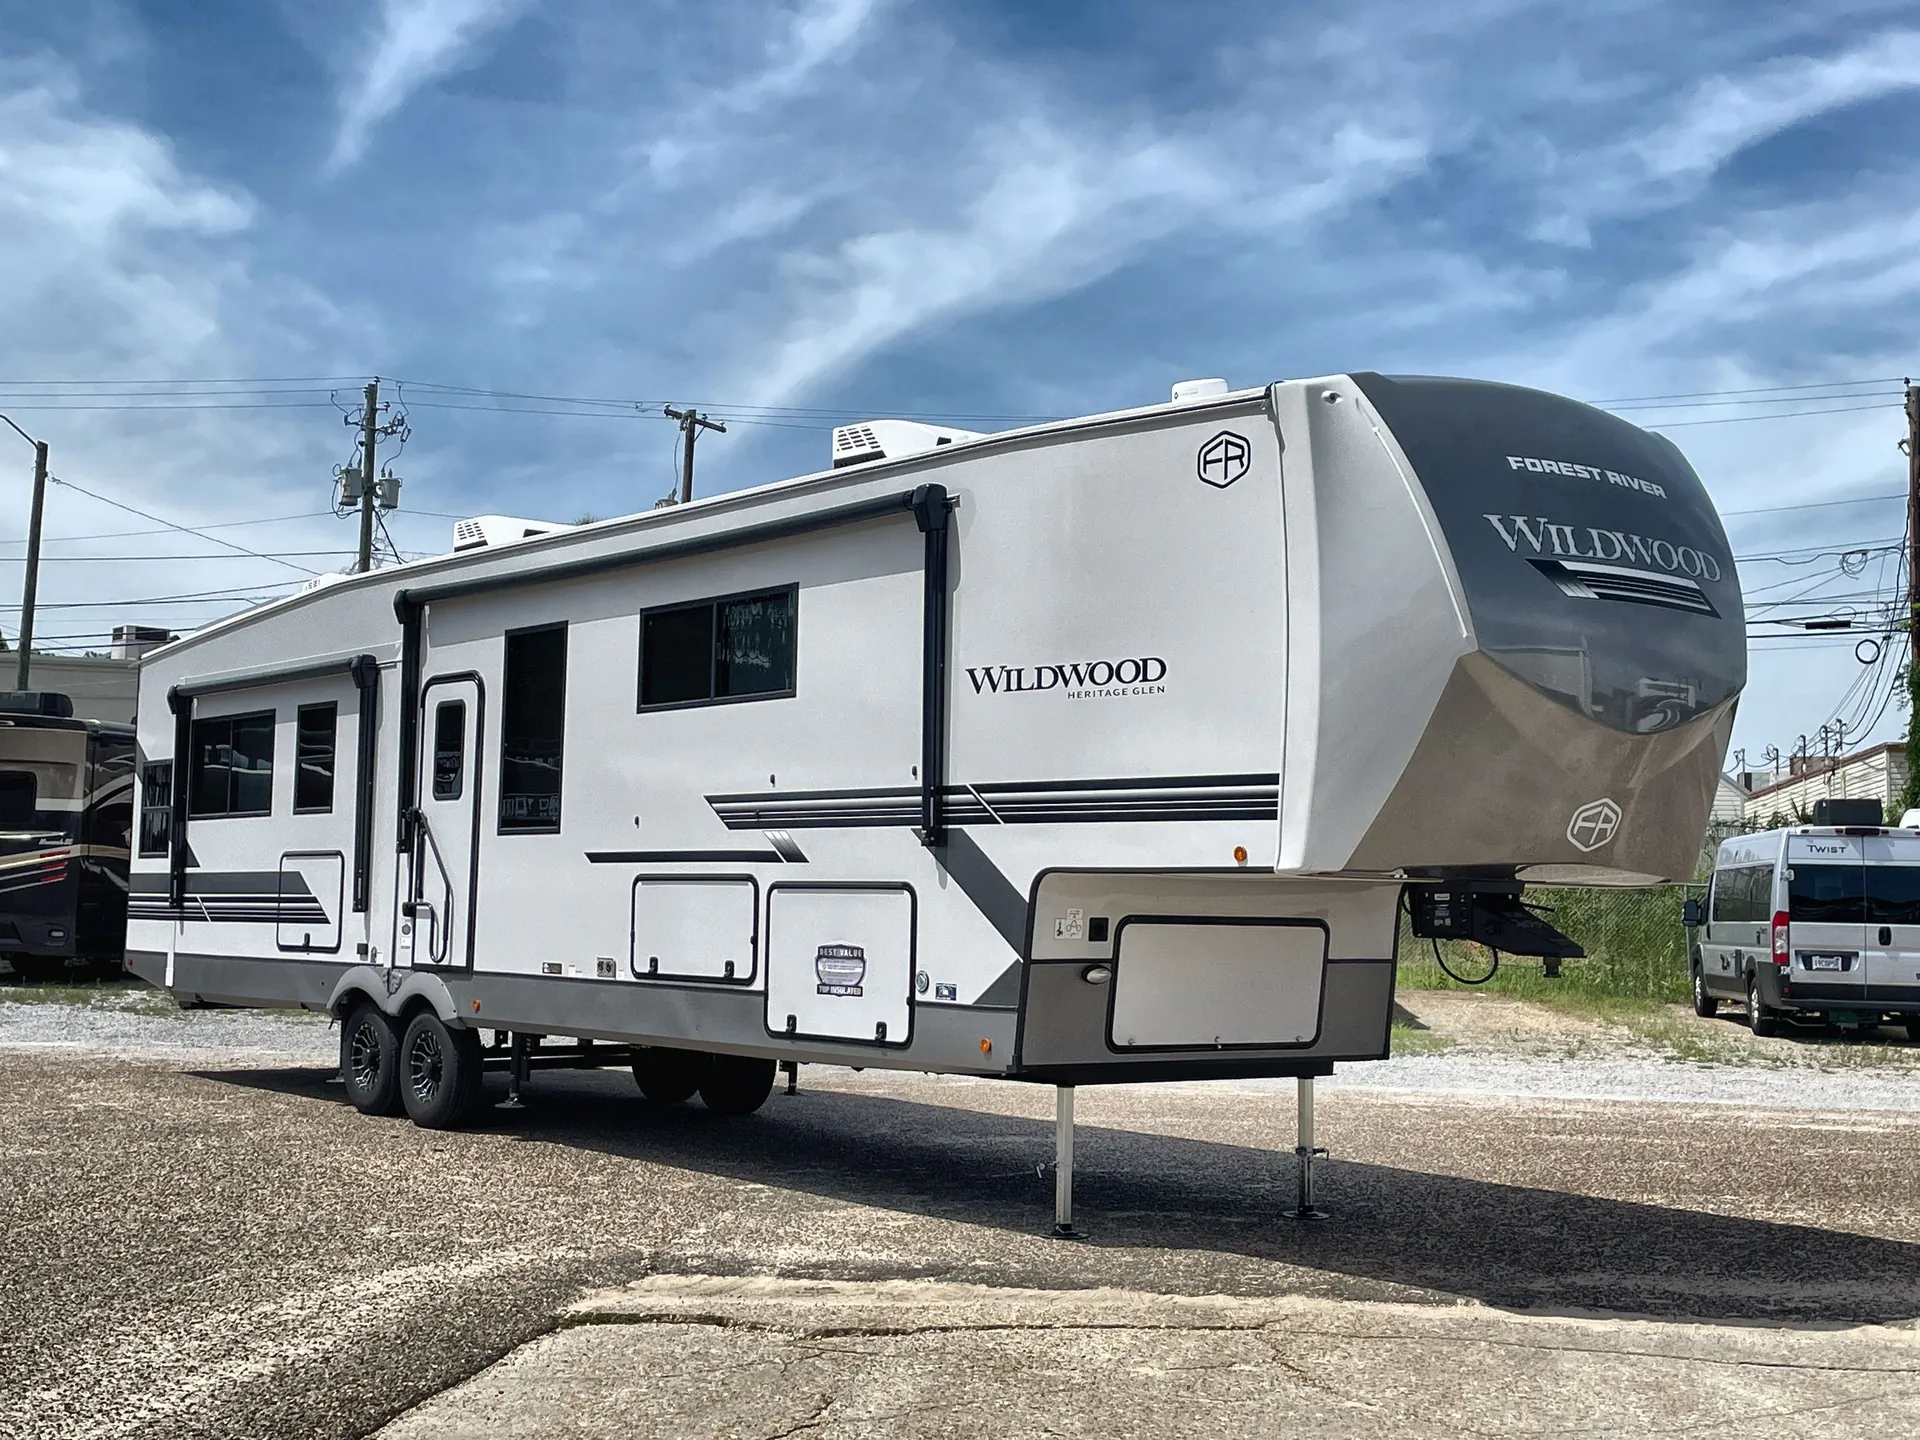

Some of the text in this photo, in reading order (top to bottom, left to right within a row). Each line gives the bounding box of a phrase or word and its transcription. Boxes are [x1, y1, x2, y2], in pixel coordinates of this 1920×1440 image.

[1506, 455, 1667, 499] FOREST RIVER
[1482, 513, 1721, 582] WILDWOOD
[965, 657, 1166, 694] WILDWOOD
[1067, 685, 1165, 699] HERITAGE GLEN
[1806, 844, 1847, 854] TWIST
